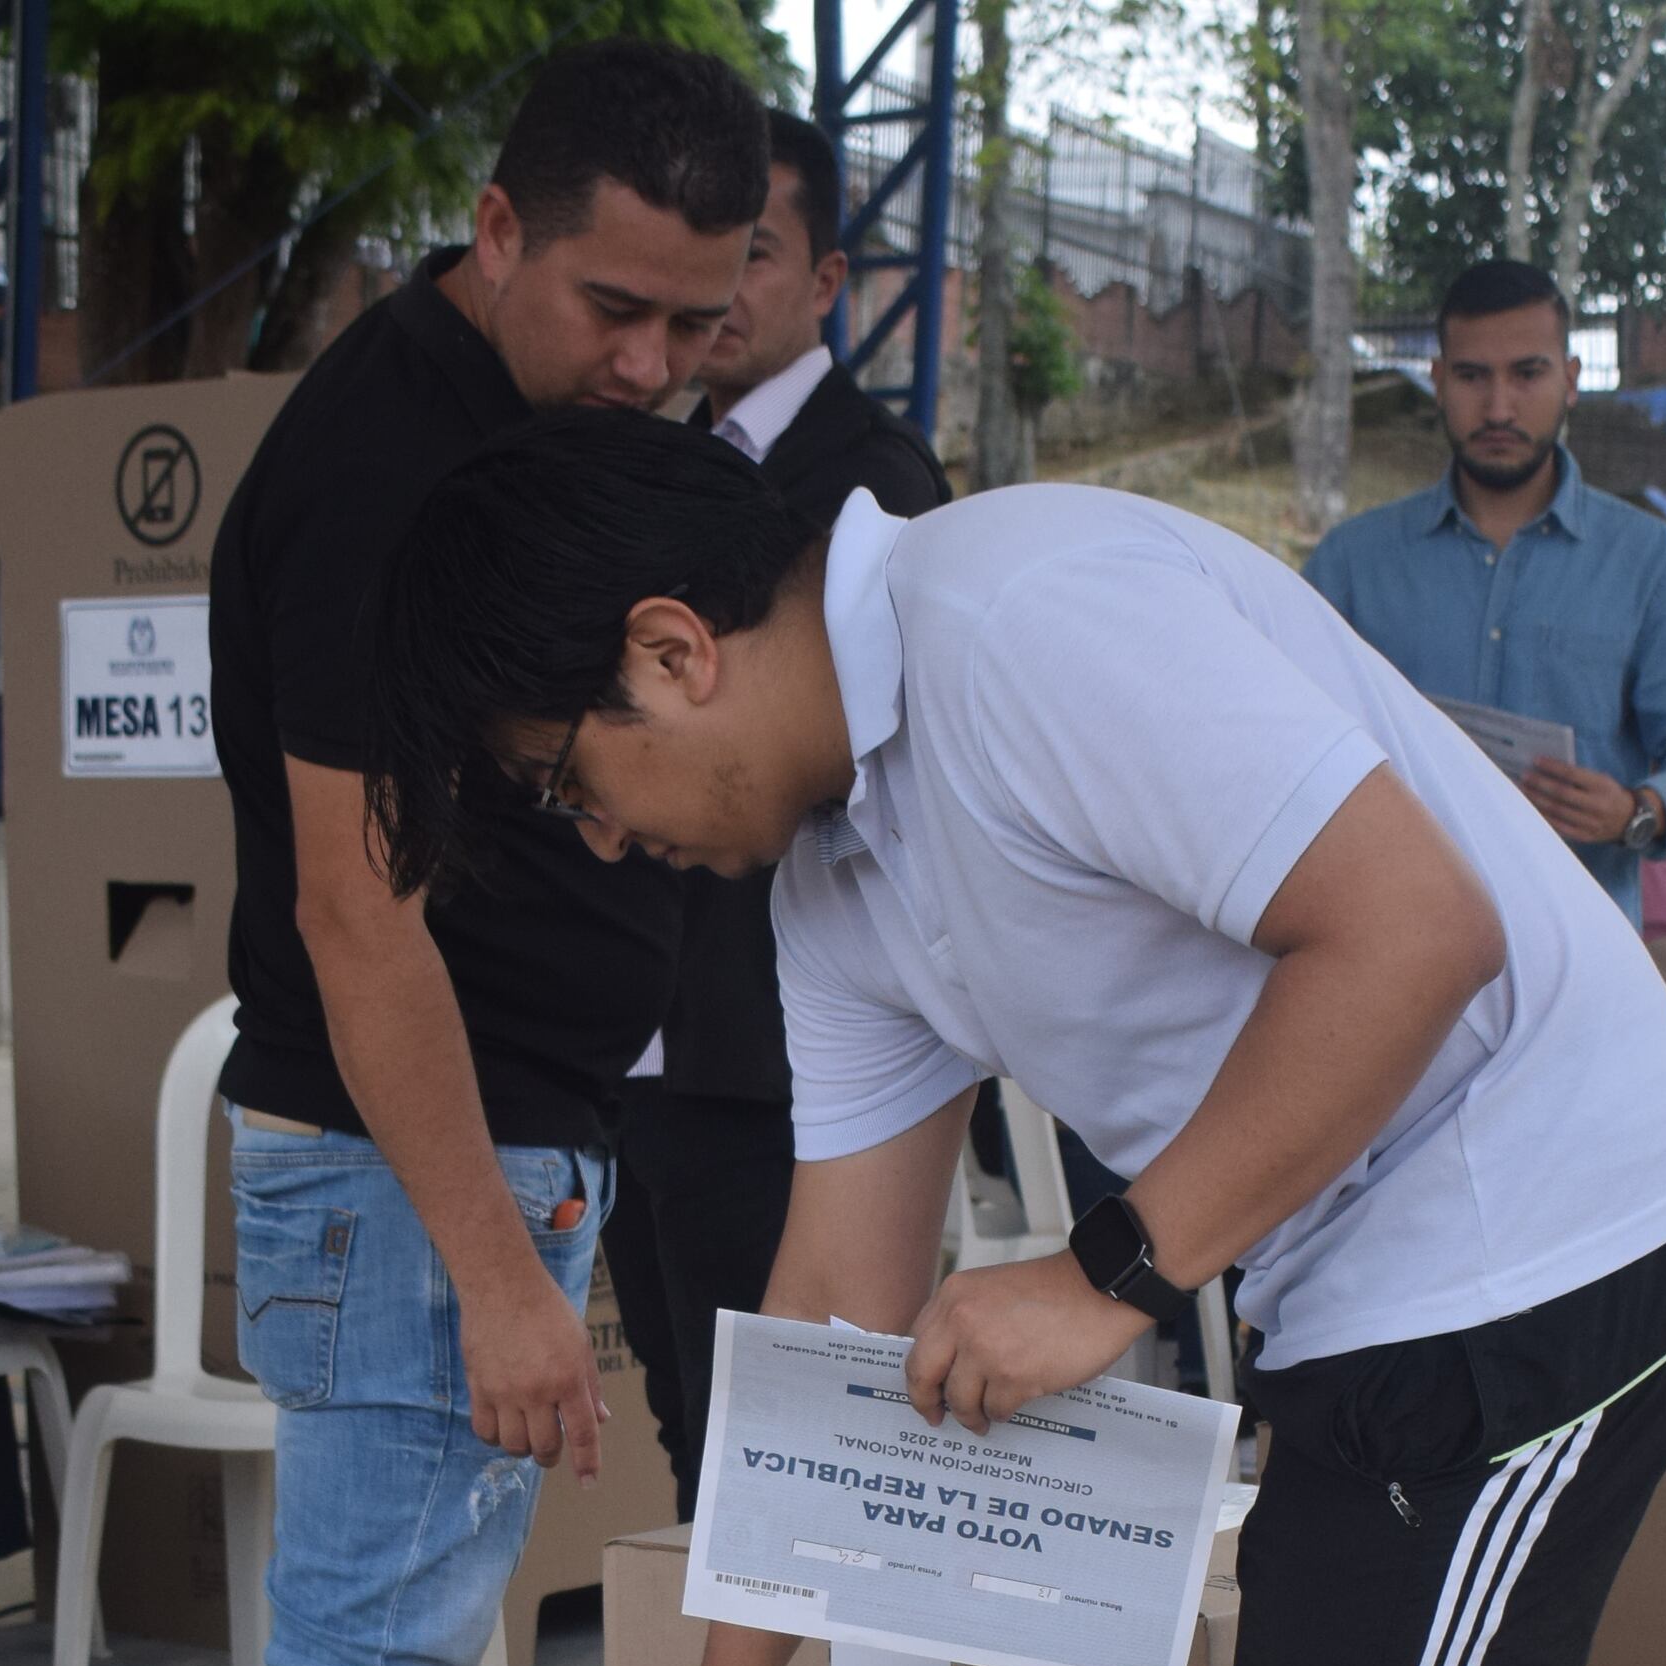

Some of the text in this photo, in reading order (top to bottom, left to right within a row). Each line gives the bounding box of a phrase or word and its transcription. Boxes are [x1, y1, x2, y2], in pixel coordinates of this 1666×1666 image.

[77, 695, 208, 738] MESA 13
[773, 1342, 900, 1369] marque el recuadro
[873, 1389, 910, 1402] OTAR
[1011, 1414, 1070, 1434] INSTRUC
[834, 1434, 1093, 1496] CIRCUNSCRIPCIÓN NACIONAL
[899, 1431, 1032, 1467] Marzo 8 de 2026
[742, 1447, 1175, 1548] SENADO DE LA REPÚBLICA
[862, 1501, 1042, 1552] VOTO PARA
[887, 1561, 916, 1572] jurado
